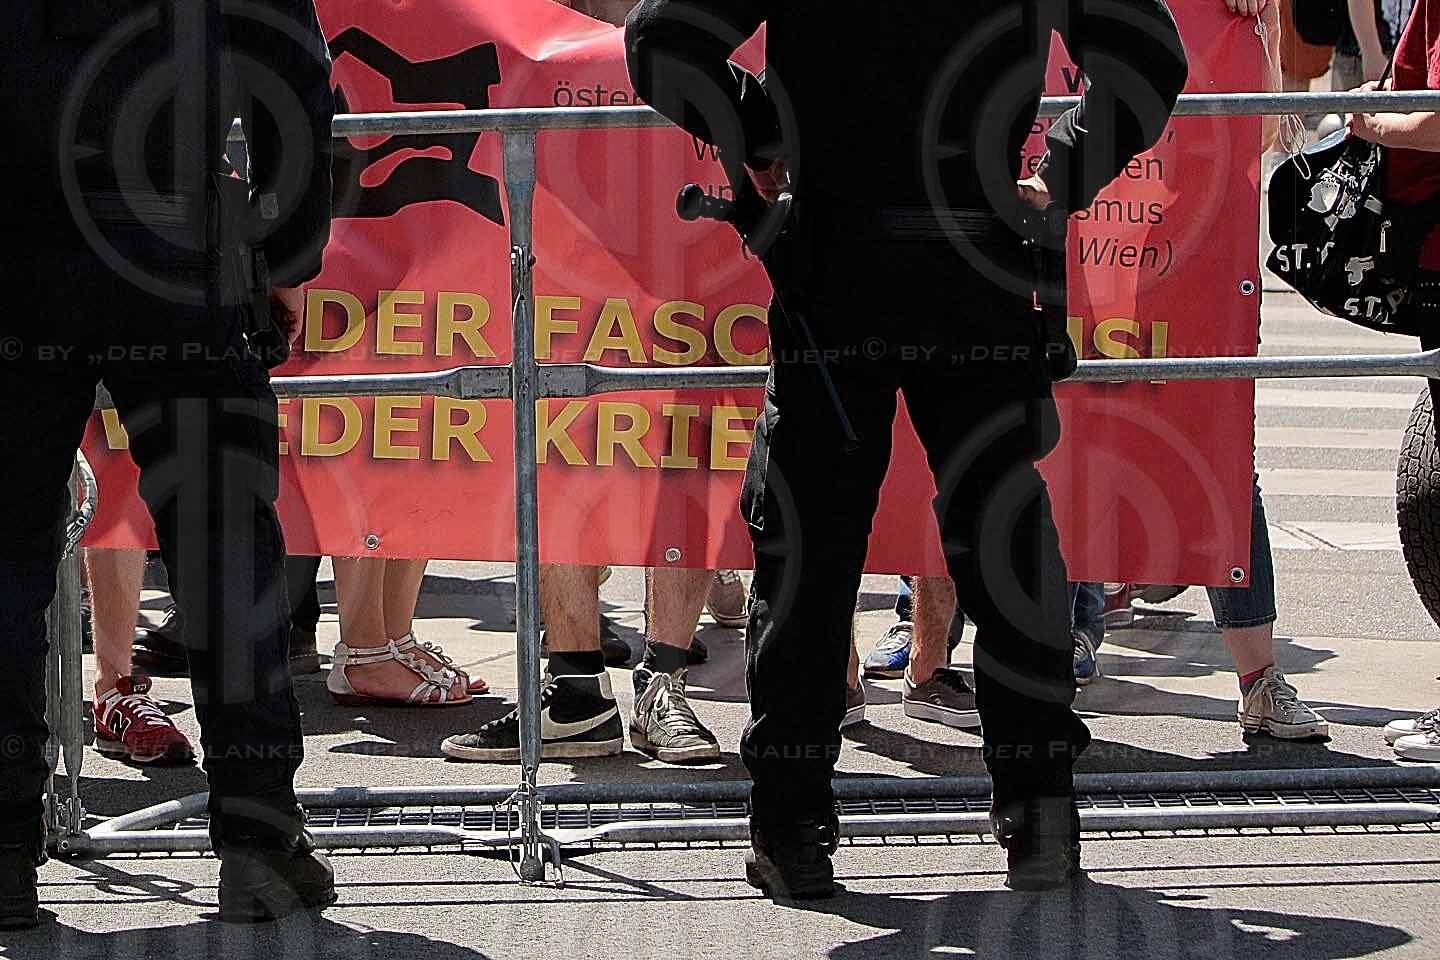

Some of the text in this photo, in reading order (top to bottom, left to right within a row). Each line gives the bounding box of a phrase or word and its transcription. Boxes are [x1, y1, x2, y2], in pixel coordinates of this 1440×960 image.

[1079, 236, 1173, 277] Wien)
[304, 289, 496, 358] DER
[536, 400, 765, 471] KRIE
